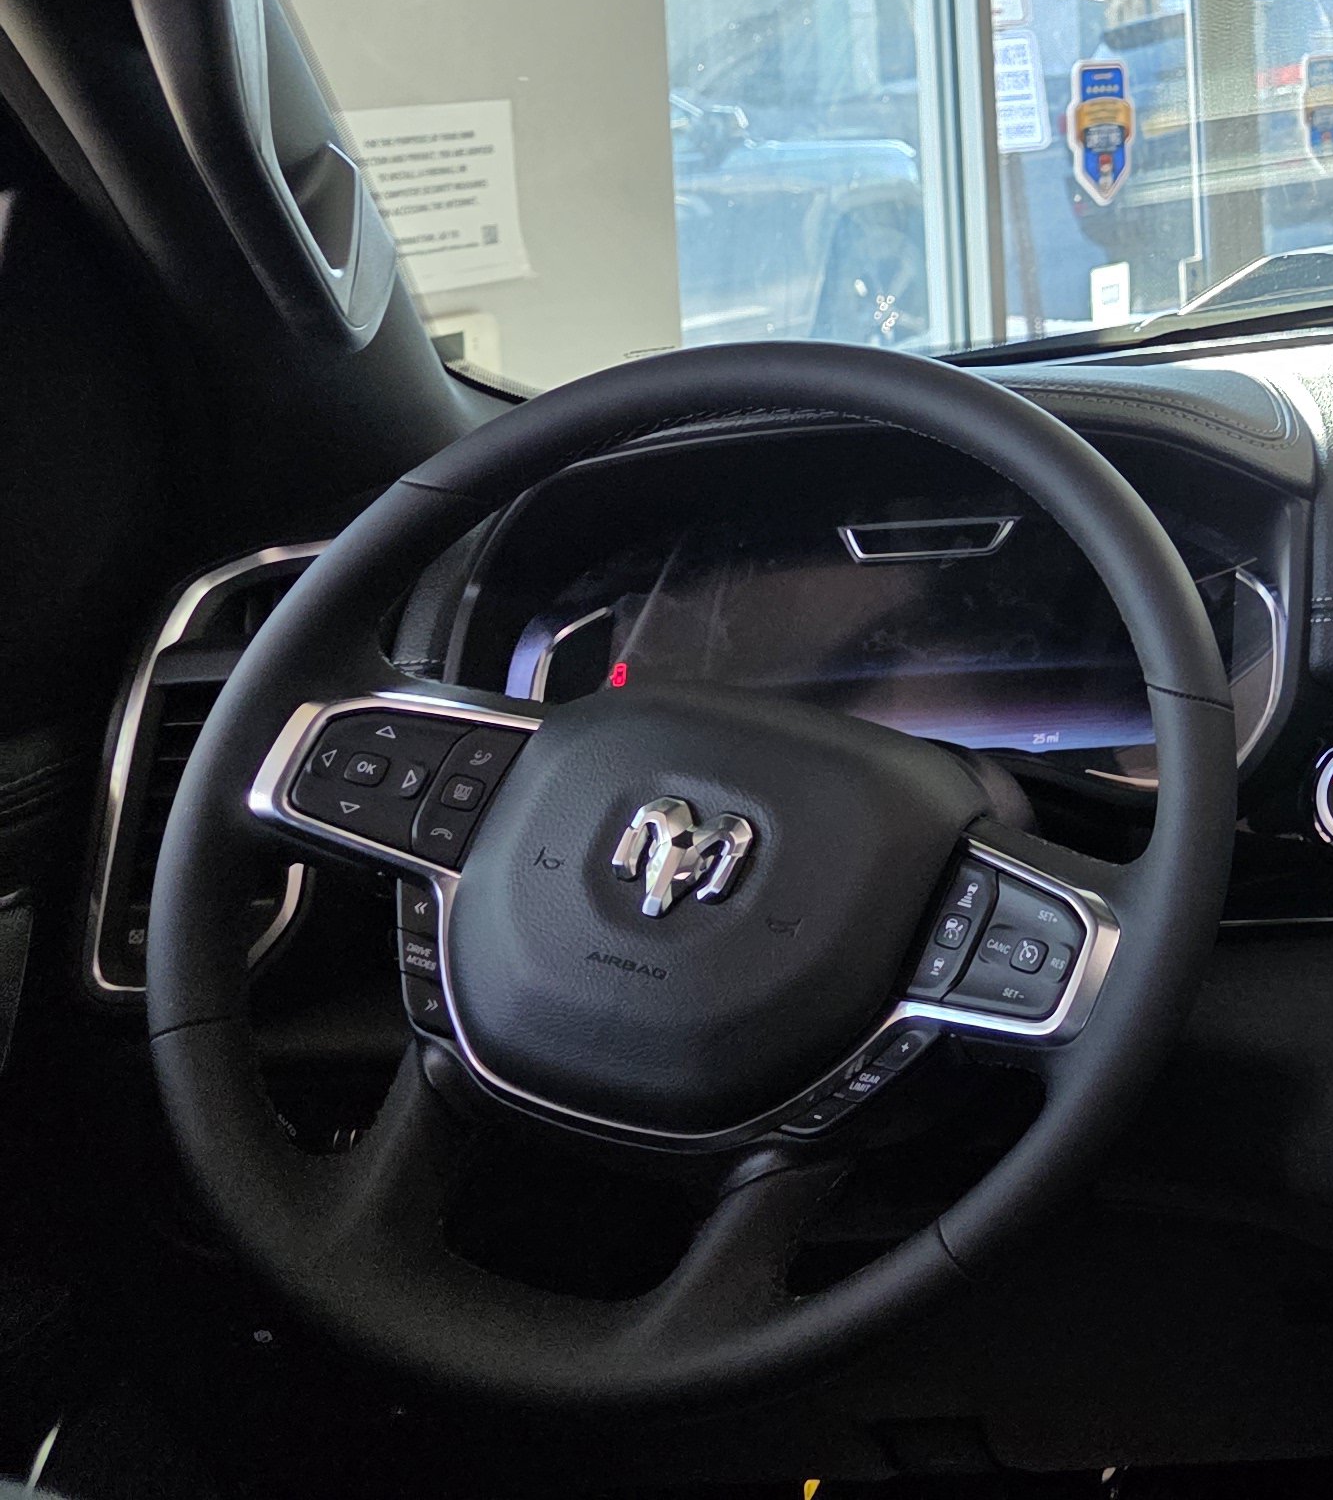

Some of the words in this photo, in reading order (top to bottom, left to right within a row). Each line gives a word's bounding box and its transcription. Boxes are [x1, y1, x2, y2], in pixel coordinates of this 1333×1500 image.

[1032, 733, 1046, 745] 25
[356, 760, 378, 776] OK
[406, 942, 432, 957] DRIVE
[986, 938, 1011, 955] CANC
[406, 955, 437, 971] MODES
[584, 951, 668, 981] AIRBAG
[1049, 957, 1066, 970] RES
[858, 1072, 881, 1084] GEAR
[848, 1081, 872, 1093] LIMIT
